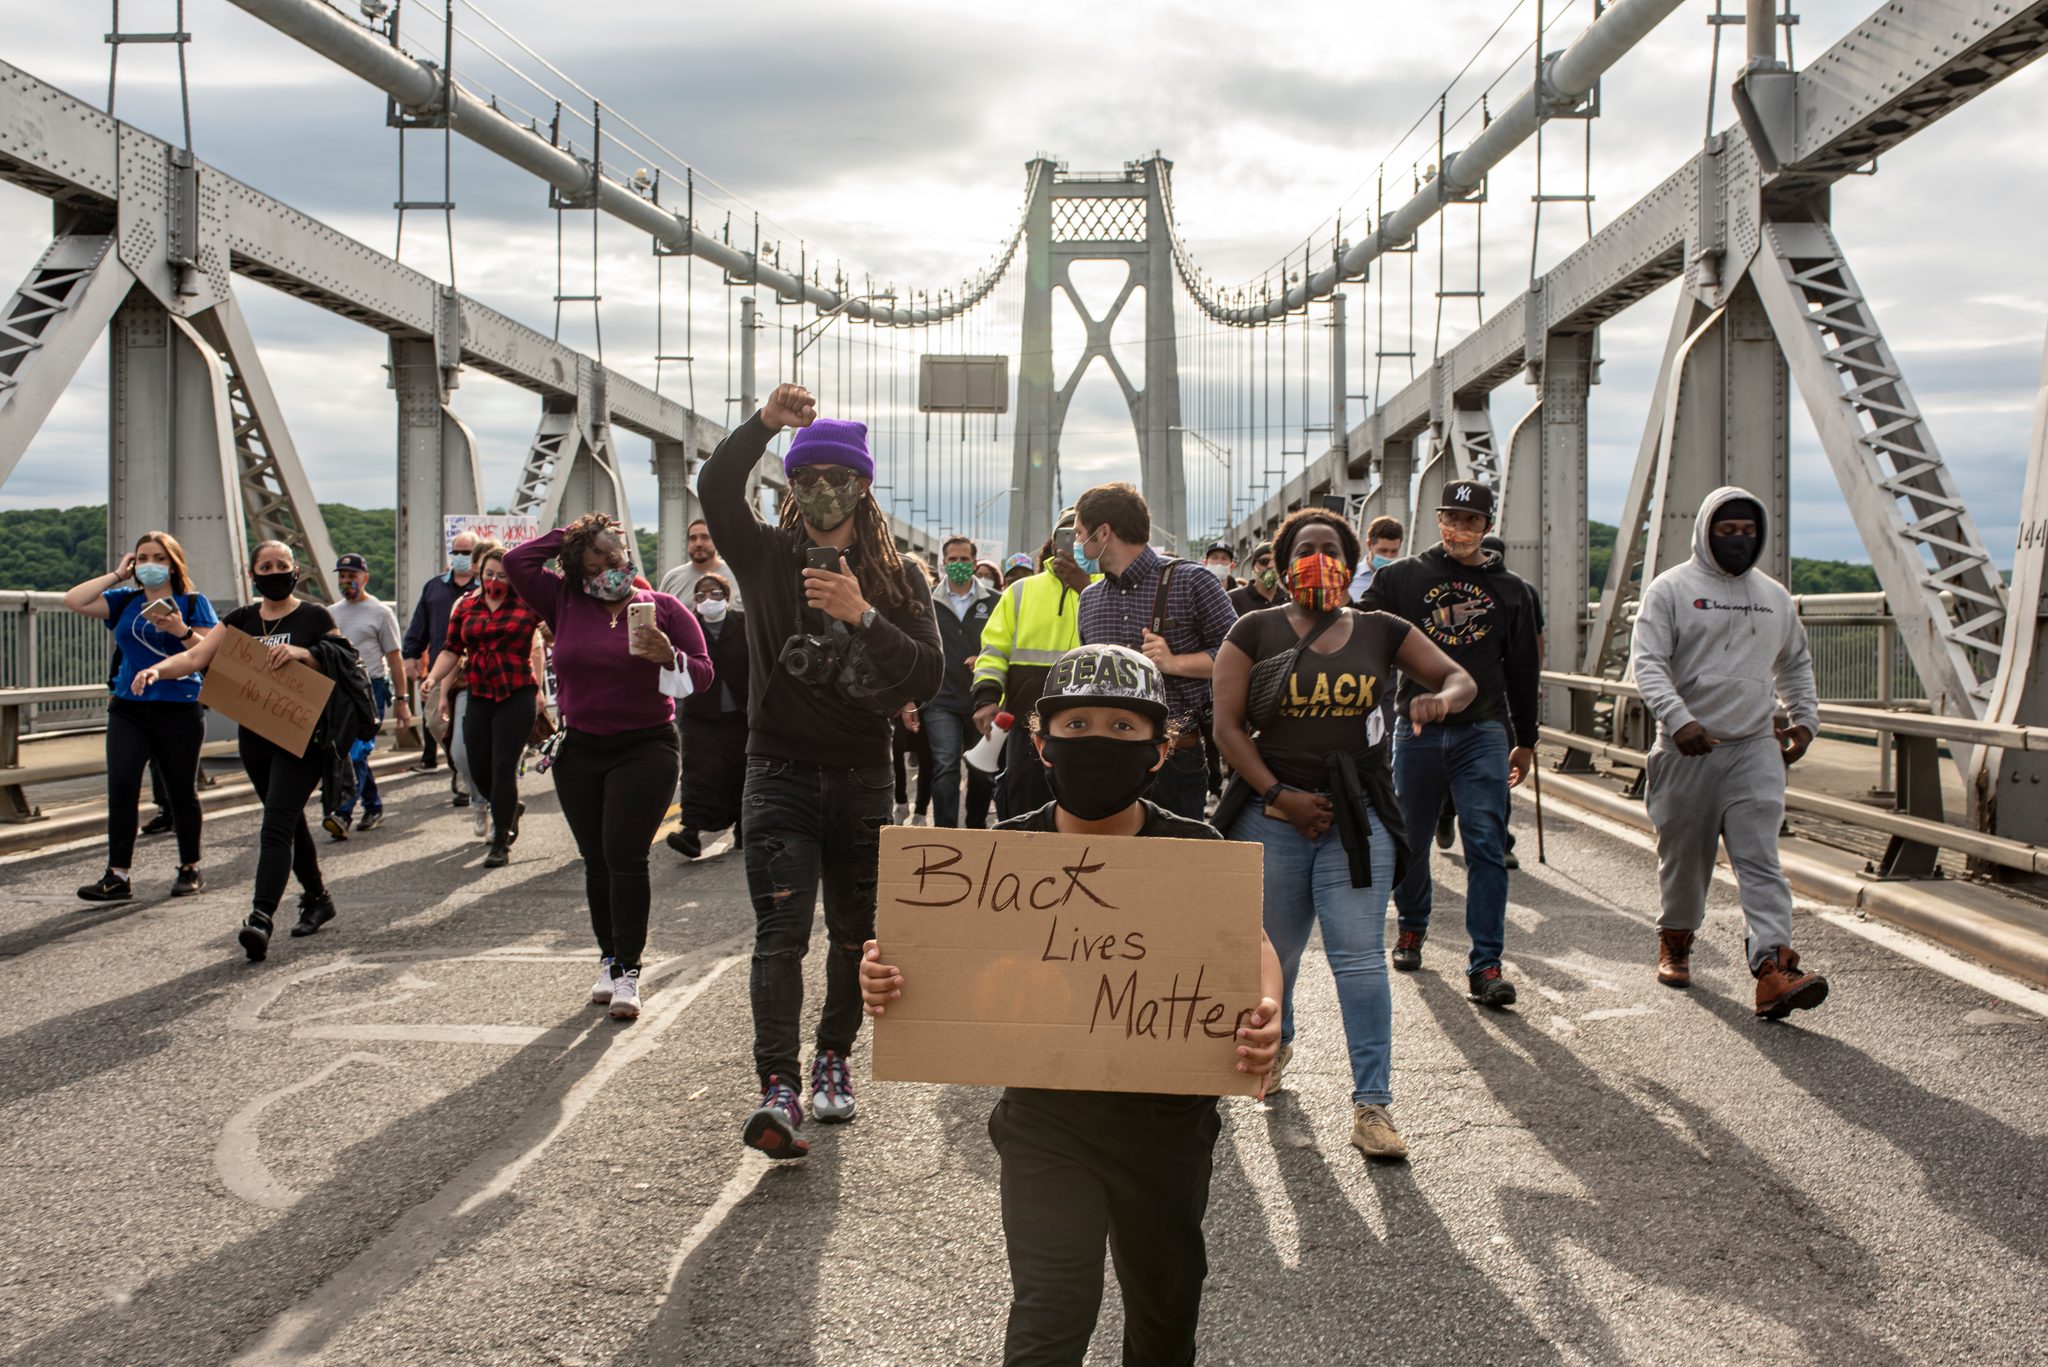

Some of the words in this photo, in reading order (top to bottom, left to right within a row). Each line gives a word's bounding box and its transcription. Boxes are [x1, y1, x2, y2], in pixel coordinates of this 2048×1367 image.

[1455, 484, 1472, 502] NY
[502, 525, 538, 540] WORLD
[1424, 581, 1496, 609] COMMUNITY
[230, 637, 253, 664] No
[1050, 654, 1154, 696] BEAST
[1281, 672, 1377, 707] LACK
[239, 679, 260, 702] No
[262, 689, 313, 730] PEACE
[895, 841, 1120, 912] Black
[1042, 915, 1147, 962] Lives
[1089, 965, 1256, 1042] Matter
